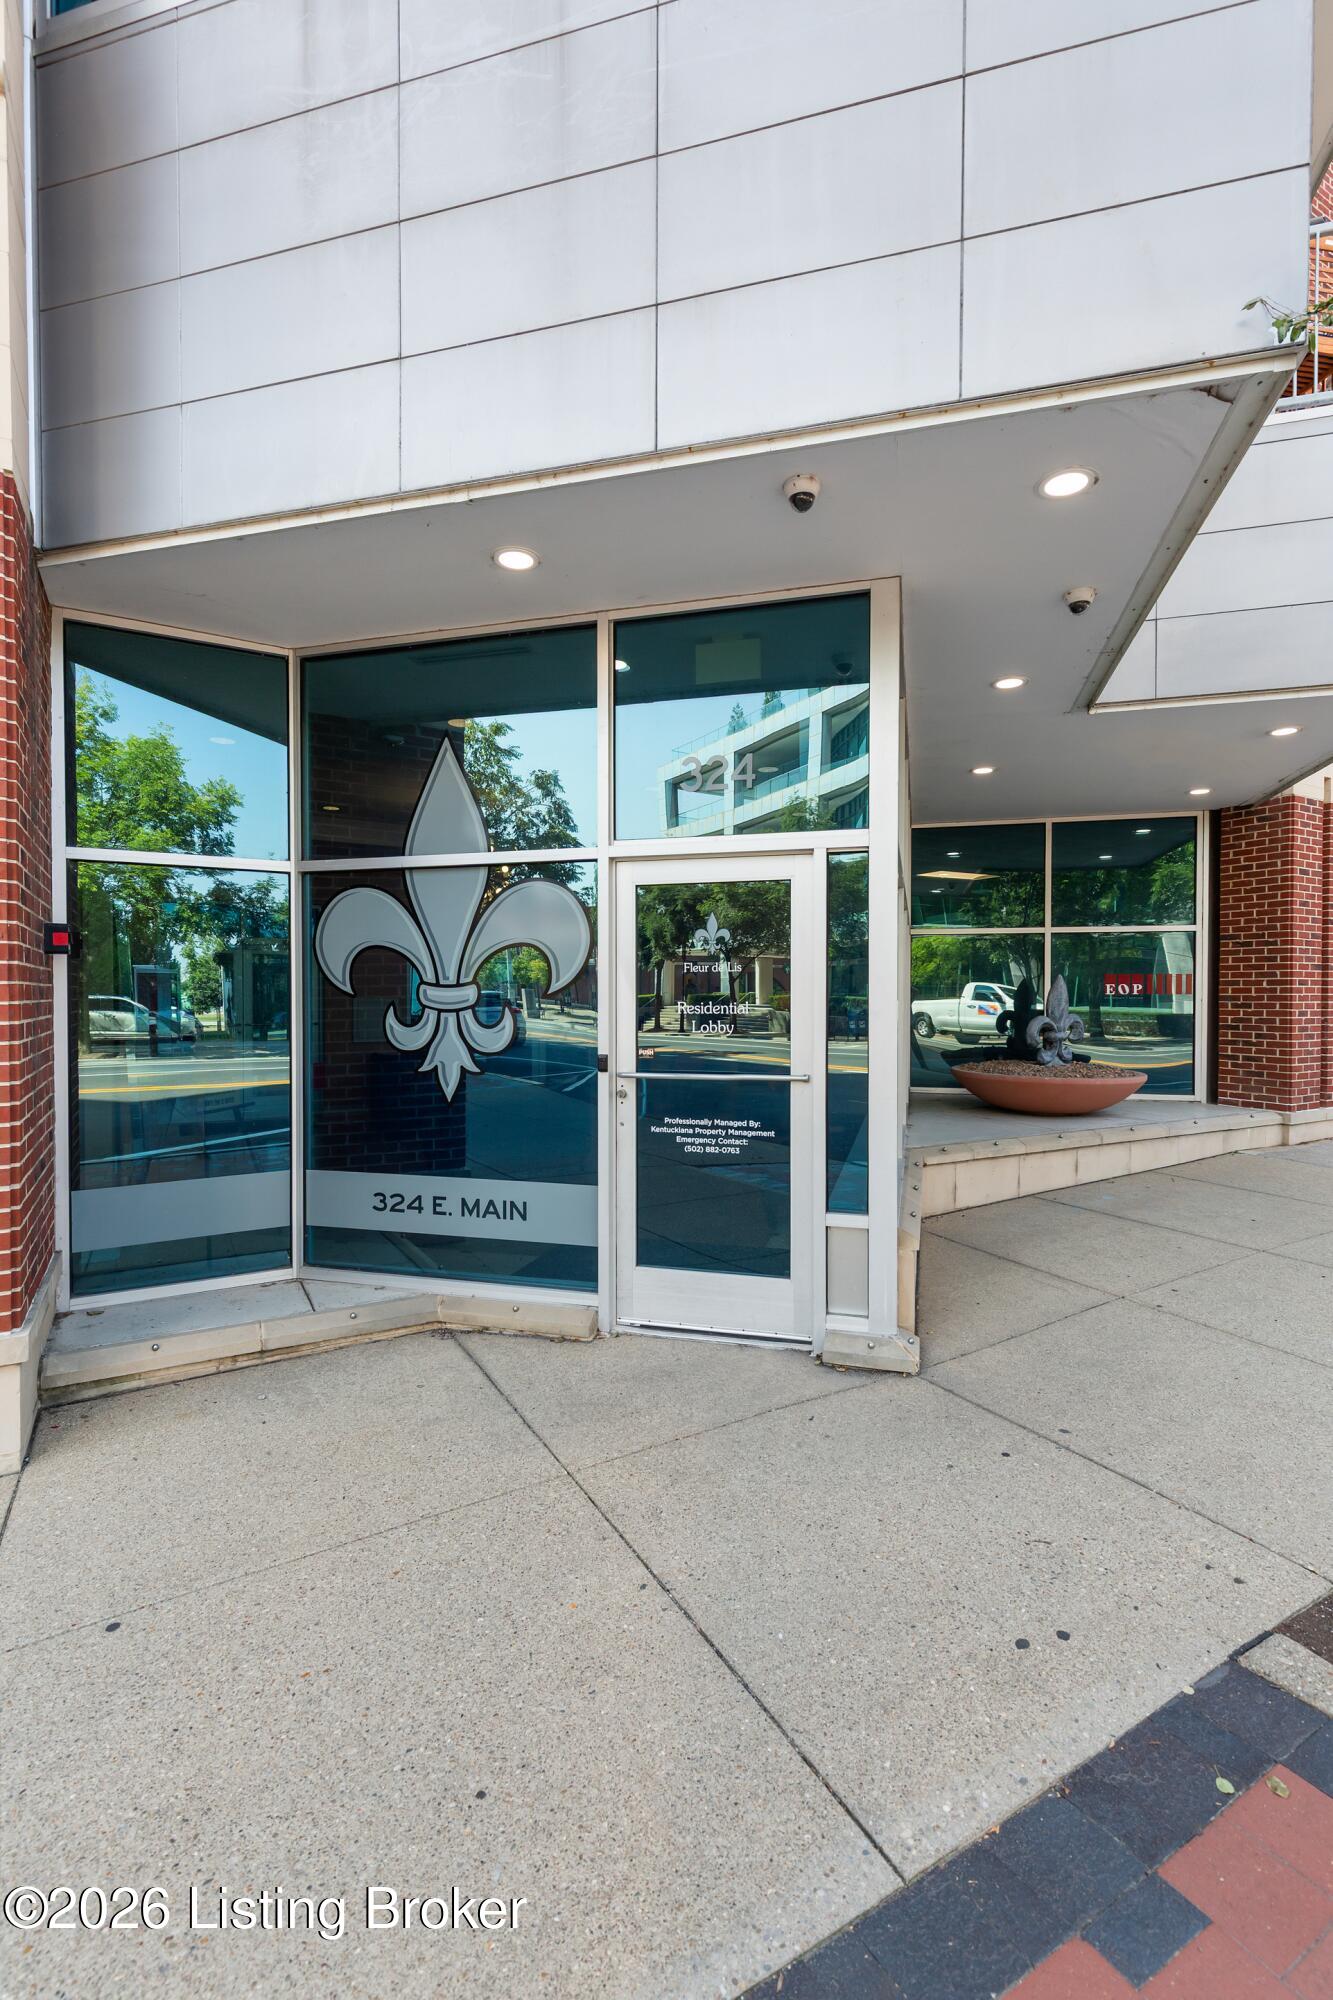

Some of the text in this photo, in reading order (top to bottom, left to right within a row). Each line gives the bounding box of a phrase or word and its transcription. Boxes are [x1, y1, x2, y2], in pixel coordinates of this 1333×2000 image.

[680, 752, 756, 792] 324
[683, 962, 742, 973] Fleur de Lis
[1105, 983, 1143, 995] EOP
[677, 1001, 749, 1015] Residential
[692, 1020, 734, 1036] Lobby
[638, 1048, 654, 1056] PUSH
[664, 1117, 761, 1129] Professionally Managed By:
[650, 1126, 775, 1138] Kentuckiana Property Management
[676, 1136, 749, 1146] Emergency Contact:
[684, 1145, 740, 1154] (502) 882-0763
[372, 1192, 528, 1221] 324 E. MAIN
